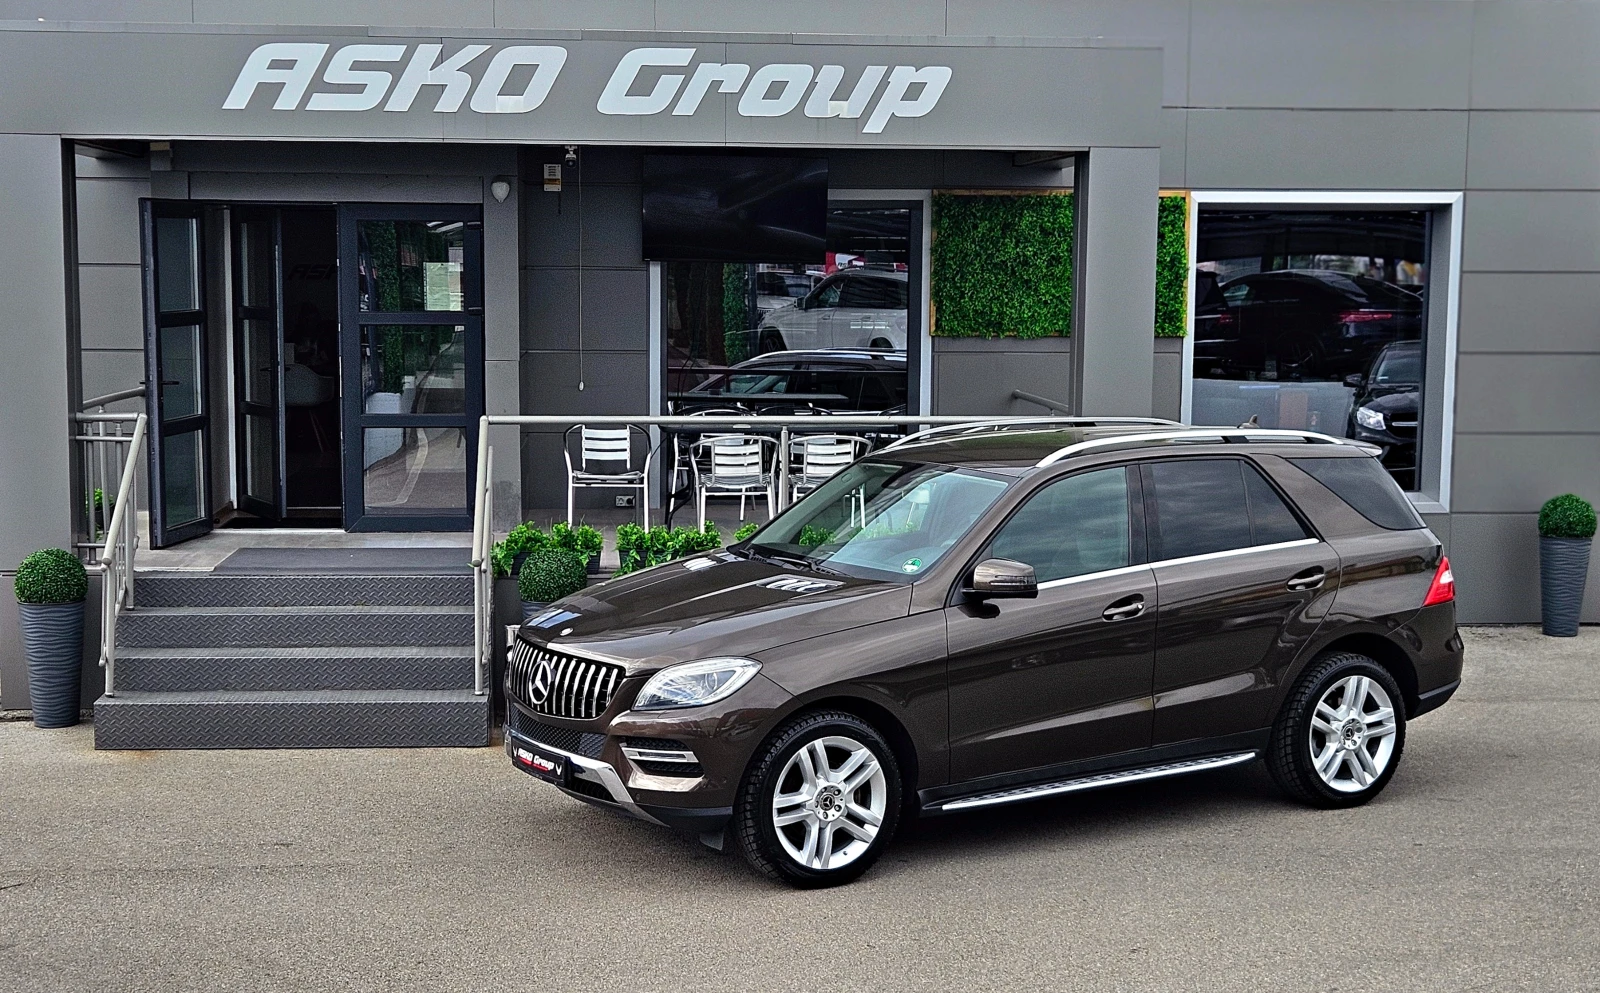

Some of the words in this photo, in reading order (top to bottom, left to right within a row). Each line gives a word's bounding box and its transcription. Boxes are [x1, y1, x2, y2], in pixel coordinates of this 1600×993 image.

[222, 43, 568, 113] ASKO
[596, 47, 953, 133] Group
[533, 755, 555, 771] Group
